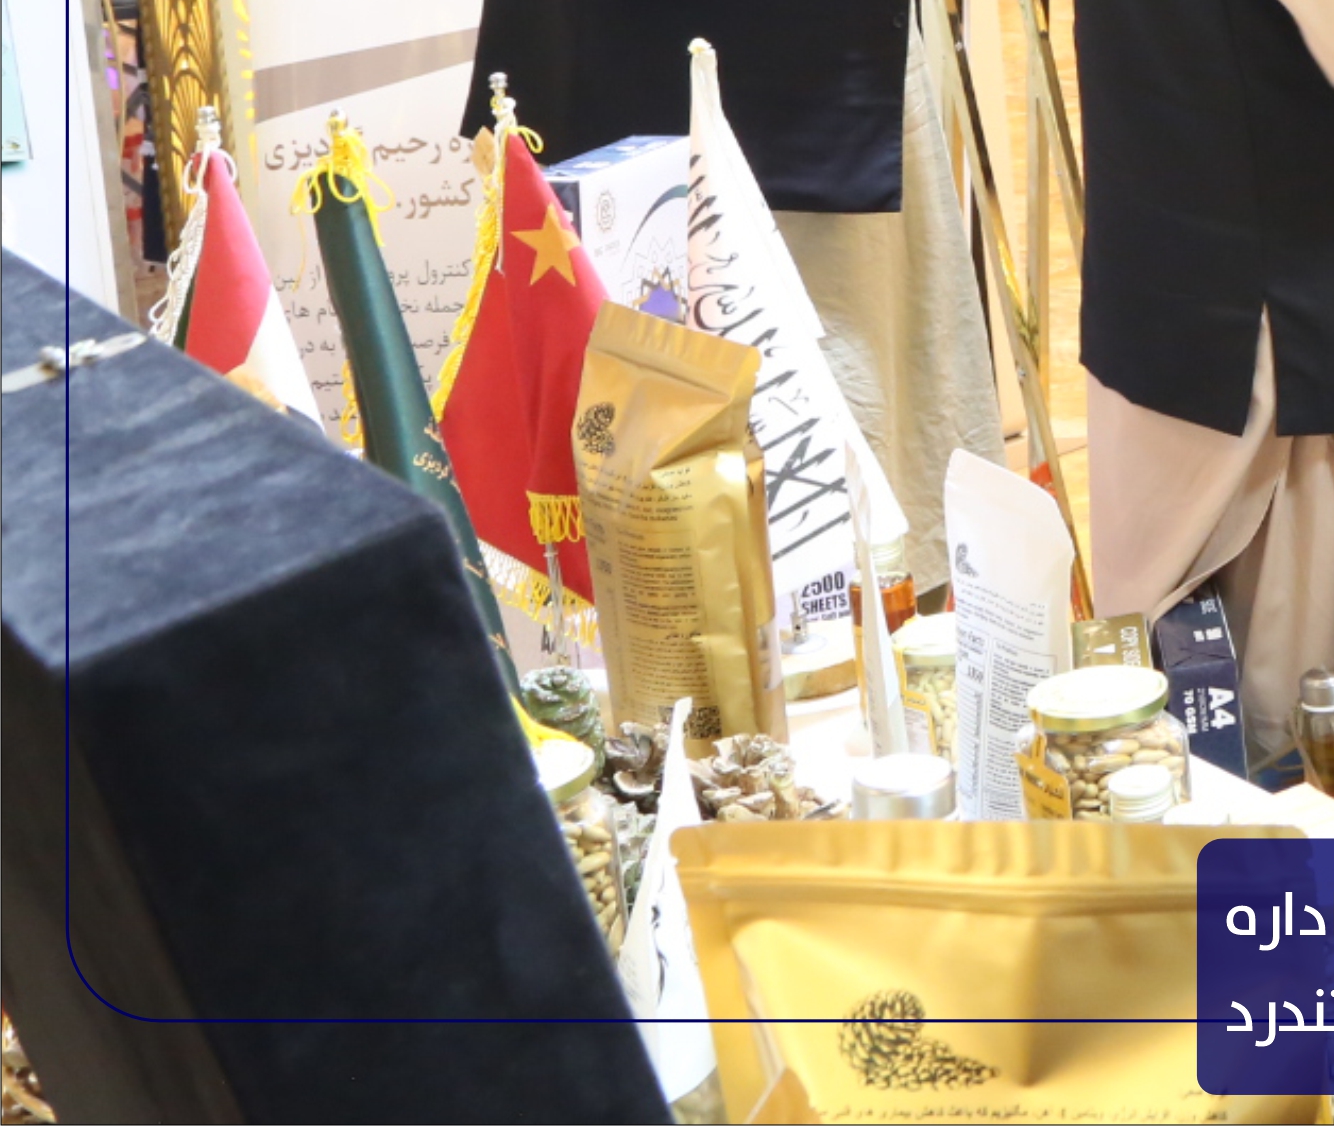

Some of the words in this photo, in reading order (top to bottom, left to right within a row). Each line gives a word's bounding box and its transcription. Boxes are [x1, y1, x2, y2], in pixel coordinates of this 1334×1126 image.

[372, 135, 443, 164] رحیم
[417, 259, 472, 286] کنترول
[801, 592, 848, 615] SHEETS
[1183, 689, 1195, 705] 70
[1207, 686, 1237, 731] A4
